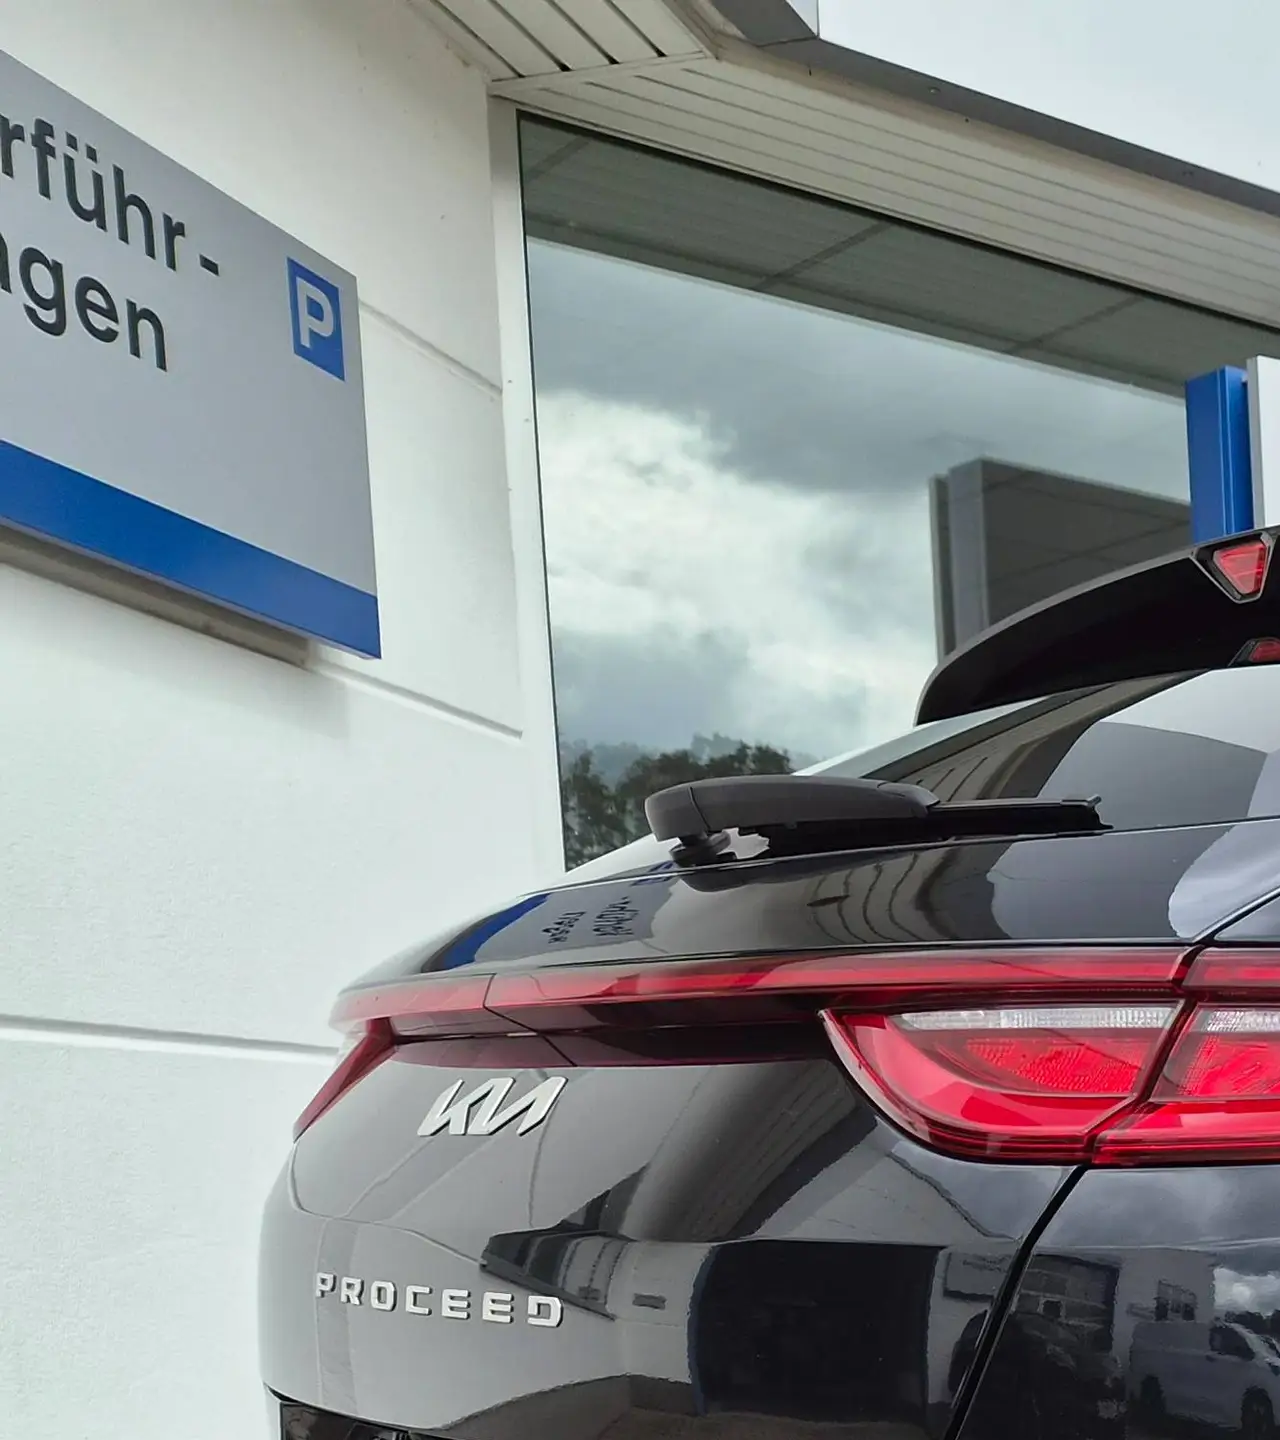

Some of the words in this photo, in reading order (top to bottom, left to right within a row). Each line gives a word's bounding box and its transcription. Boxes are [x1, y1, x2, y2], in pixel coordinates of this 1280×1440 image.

[0, 231, 168, 373] gen
[295, 276, 335, 350] P
[416, 1076, 568, 1137] KIA
[316, 1271, 563, 1328] PROCEED
